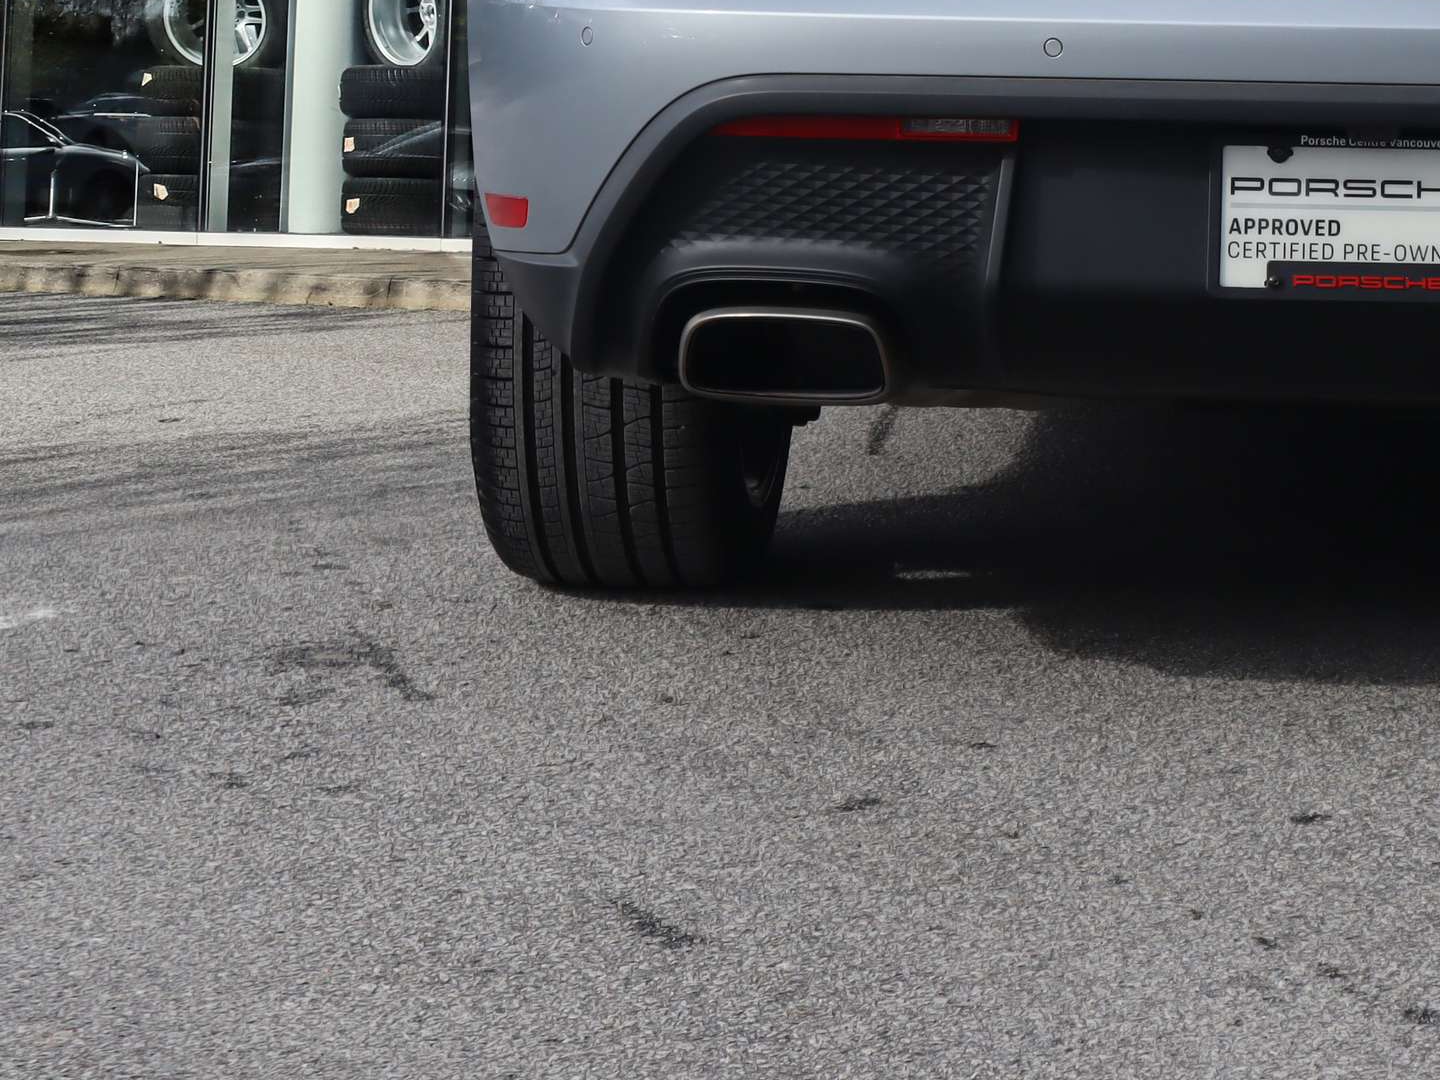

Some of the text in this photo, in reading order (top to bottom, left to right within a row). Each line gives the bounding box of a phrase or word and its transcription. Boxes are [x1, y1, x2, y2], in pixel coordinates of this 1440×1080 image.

[1300, 134, 1346, 147] Porsche
[1228, 218, 1342, 237] APPROVED
[1227, 240, 1335, 261] CERTIFIED
